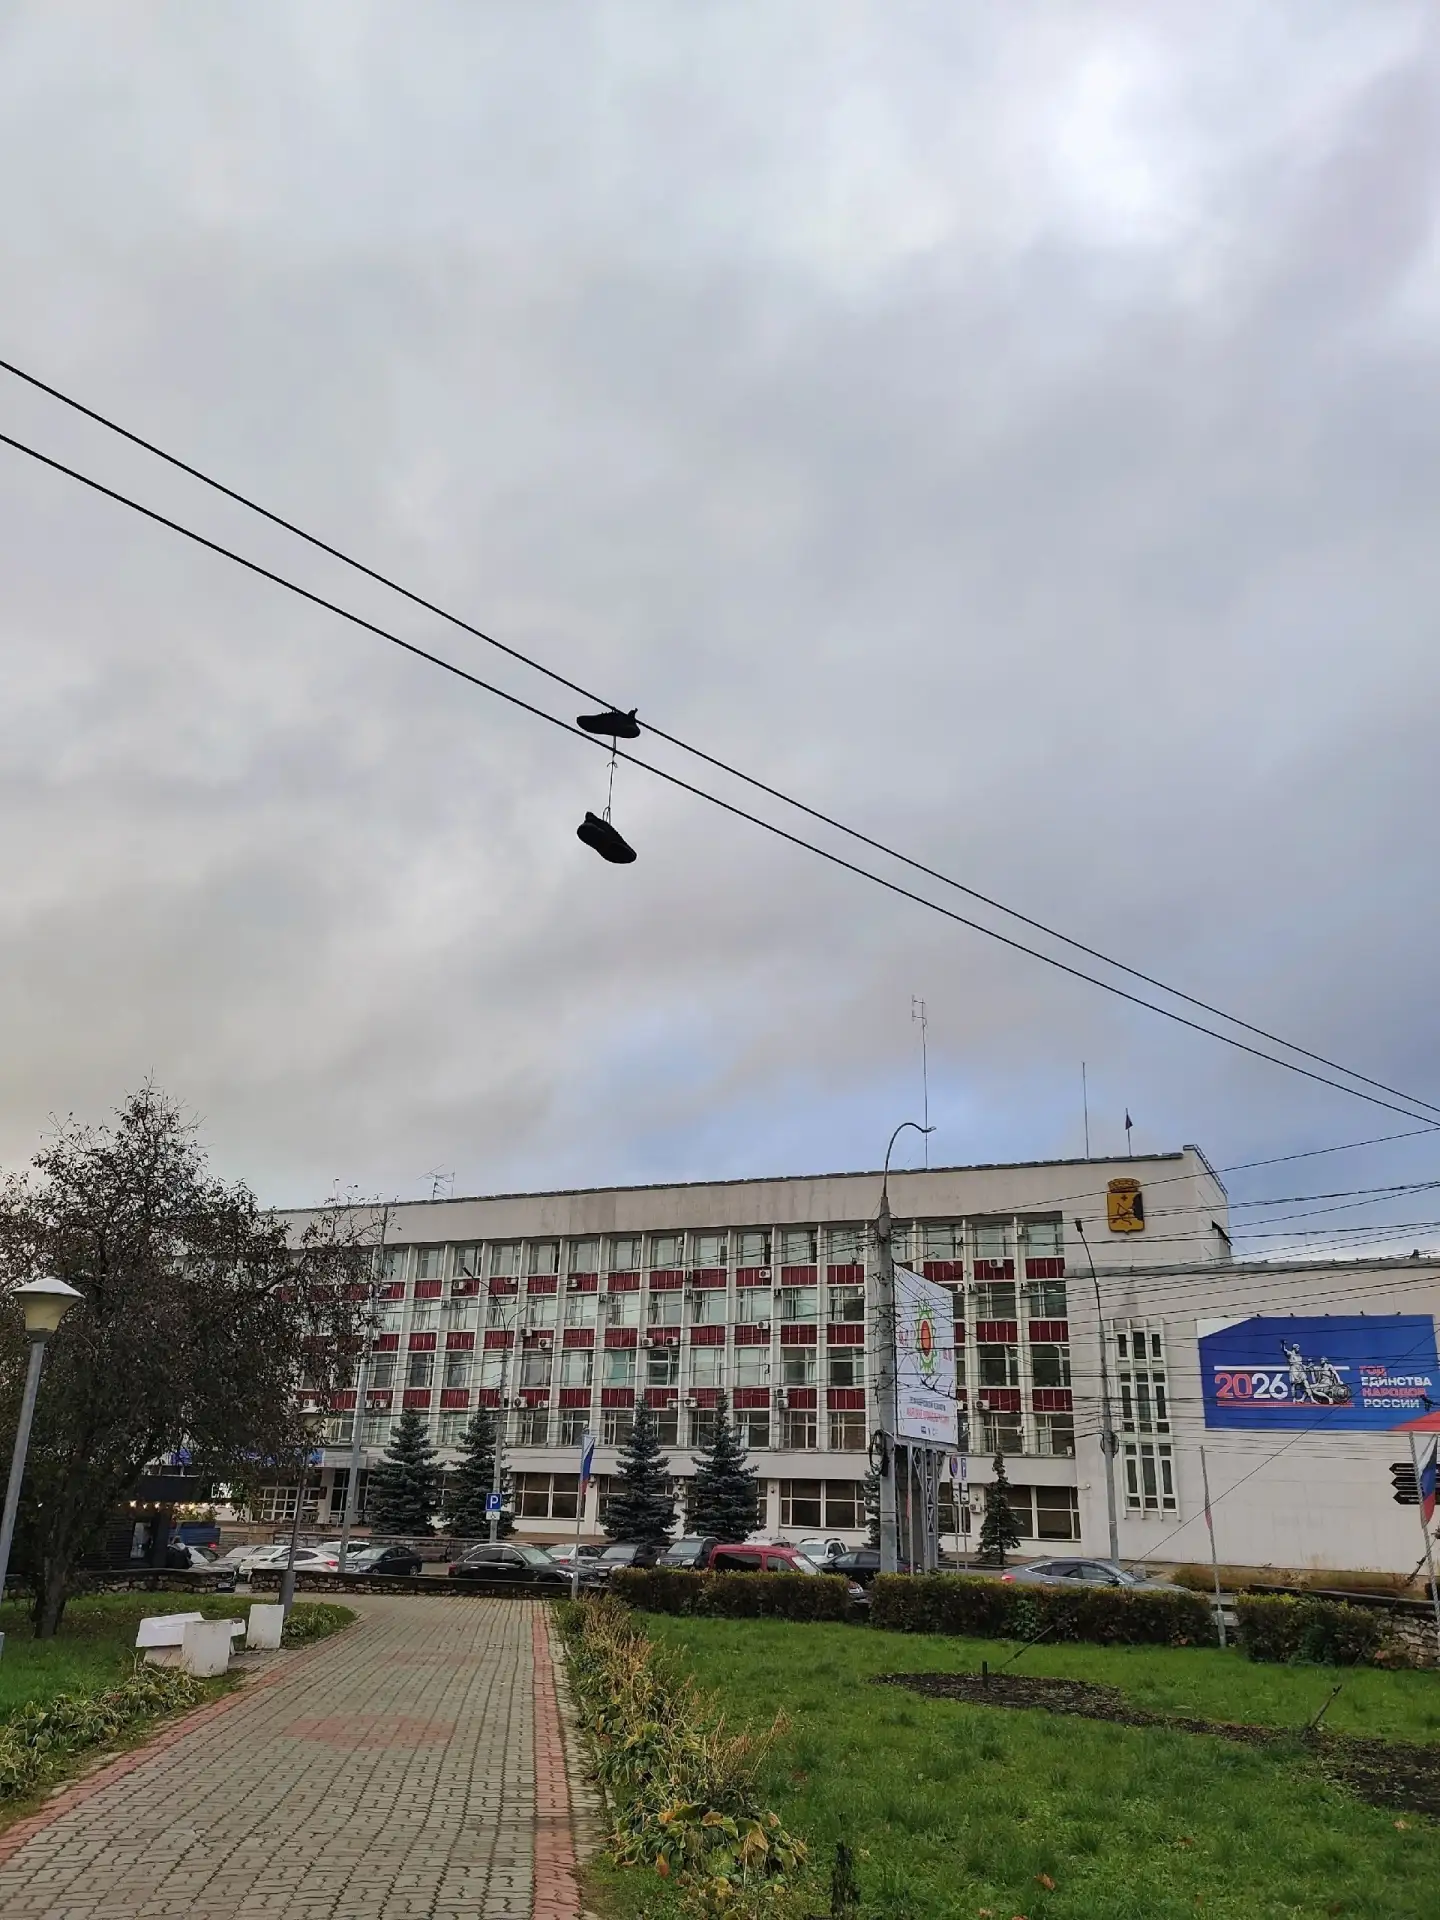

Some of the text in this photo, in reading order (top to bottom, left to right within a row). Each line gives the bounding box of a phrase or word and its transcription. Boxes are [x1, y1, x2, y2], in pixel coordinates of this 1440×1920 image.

[1214, 1372, 1288, 1400] 2026
[1361, 1377, 1432, 1387] ЕДИНСТВА
[1363, 1399, 1420, 1408] РОССИИ
